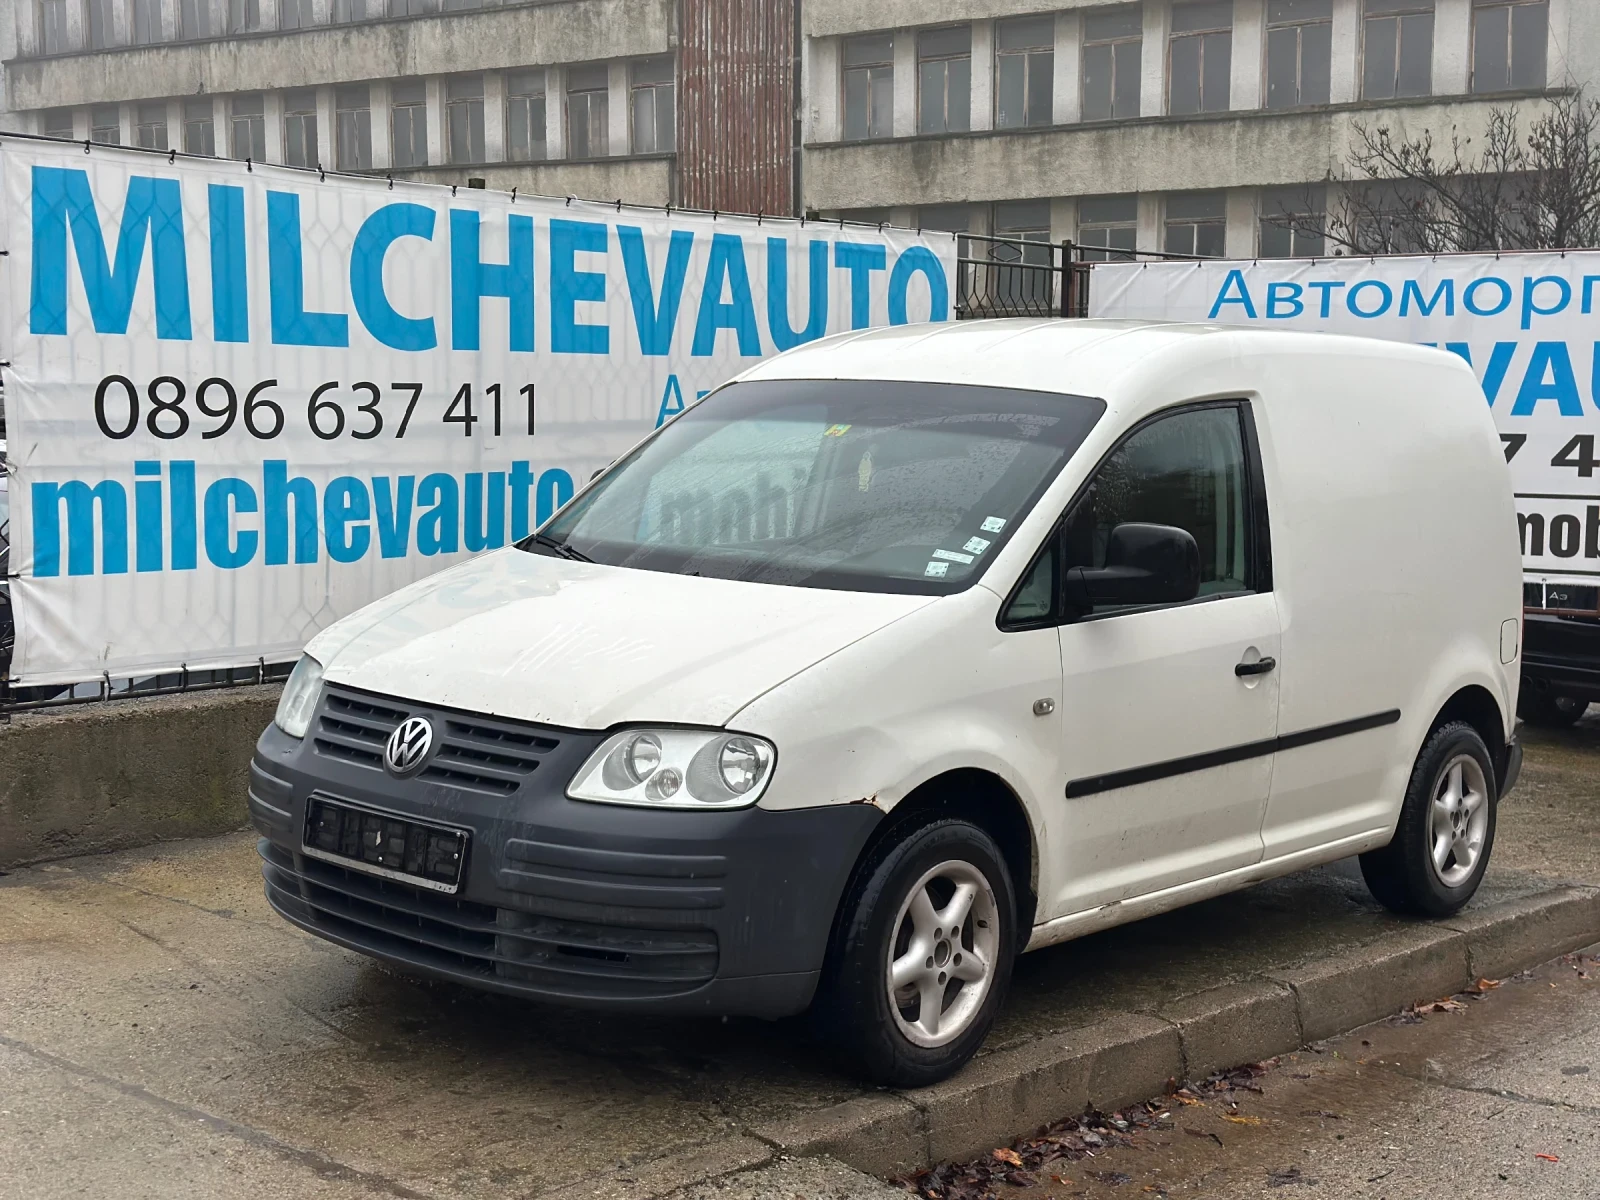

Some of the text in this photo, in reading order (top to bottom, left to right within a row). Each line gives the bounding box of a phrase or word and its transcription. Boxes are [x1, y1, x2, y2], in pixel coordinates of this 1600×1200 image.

[30, 165, 949, 357] MILCHEVAUTO
[94, 374, 535, 440] 0896 637 411
